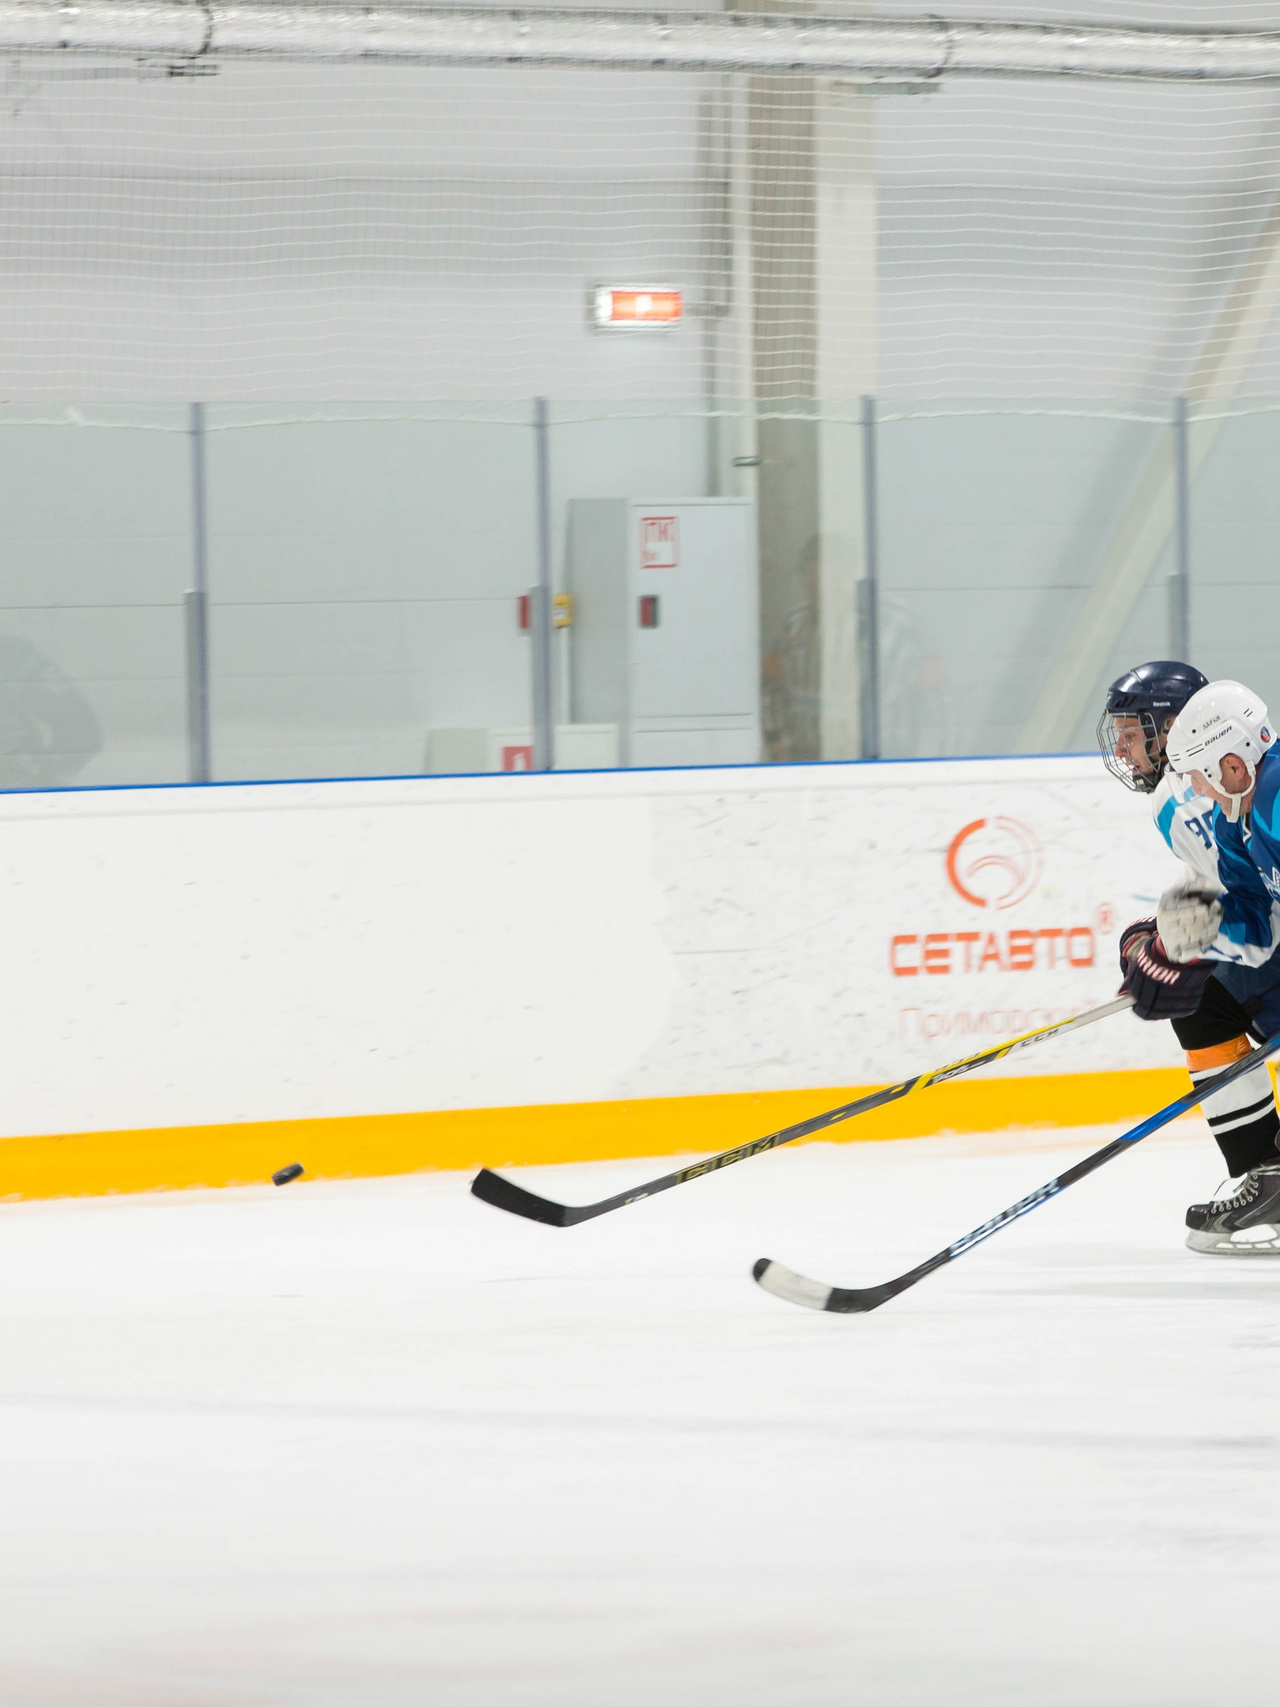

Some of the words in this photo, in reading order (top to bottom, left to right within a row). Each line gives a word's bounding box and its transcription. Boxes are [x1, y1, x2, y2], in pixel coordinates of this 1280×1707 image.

[1204, 725, 1232, 747] BAUER
[890, 927, 1096, 977] СЕТАВТО
[674, 1132, 781, 1186] CCM
